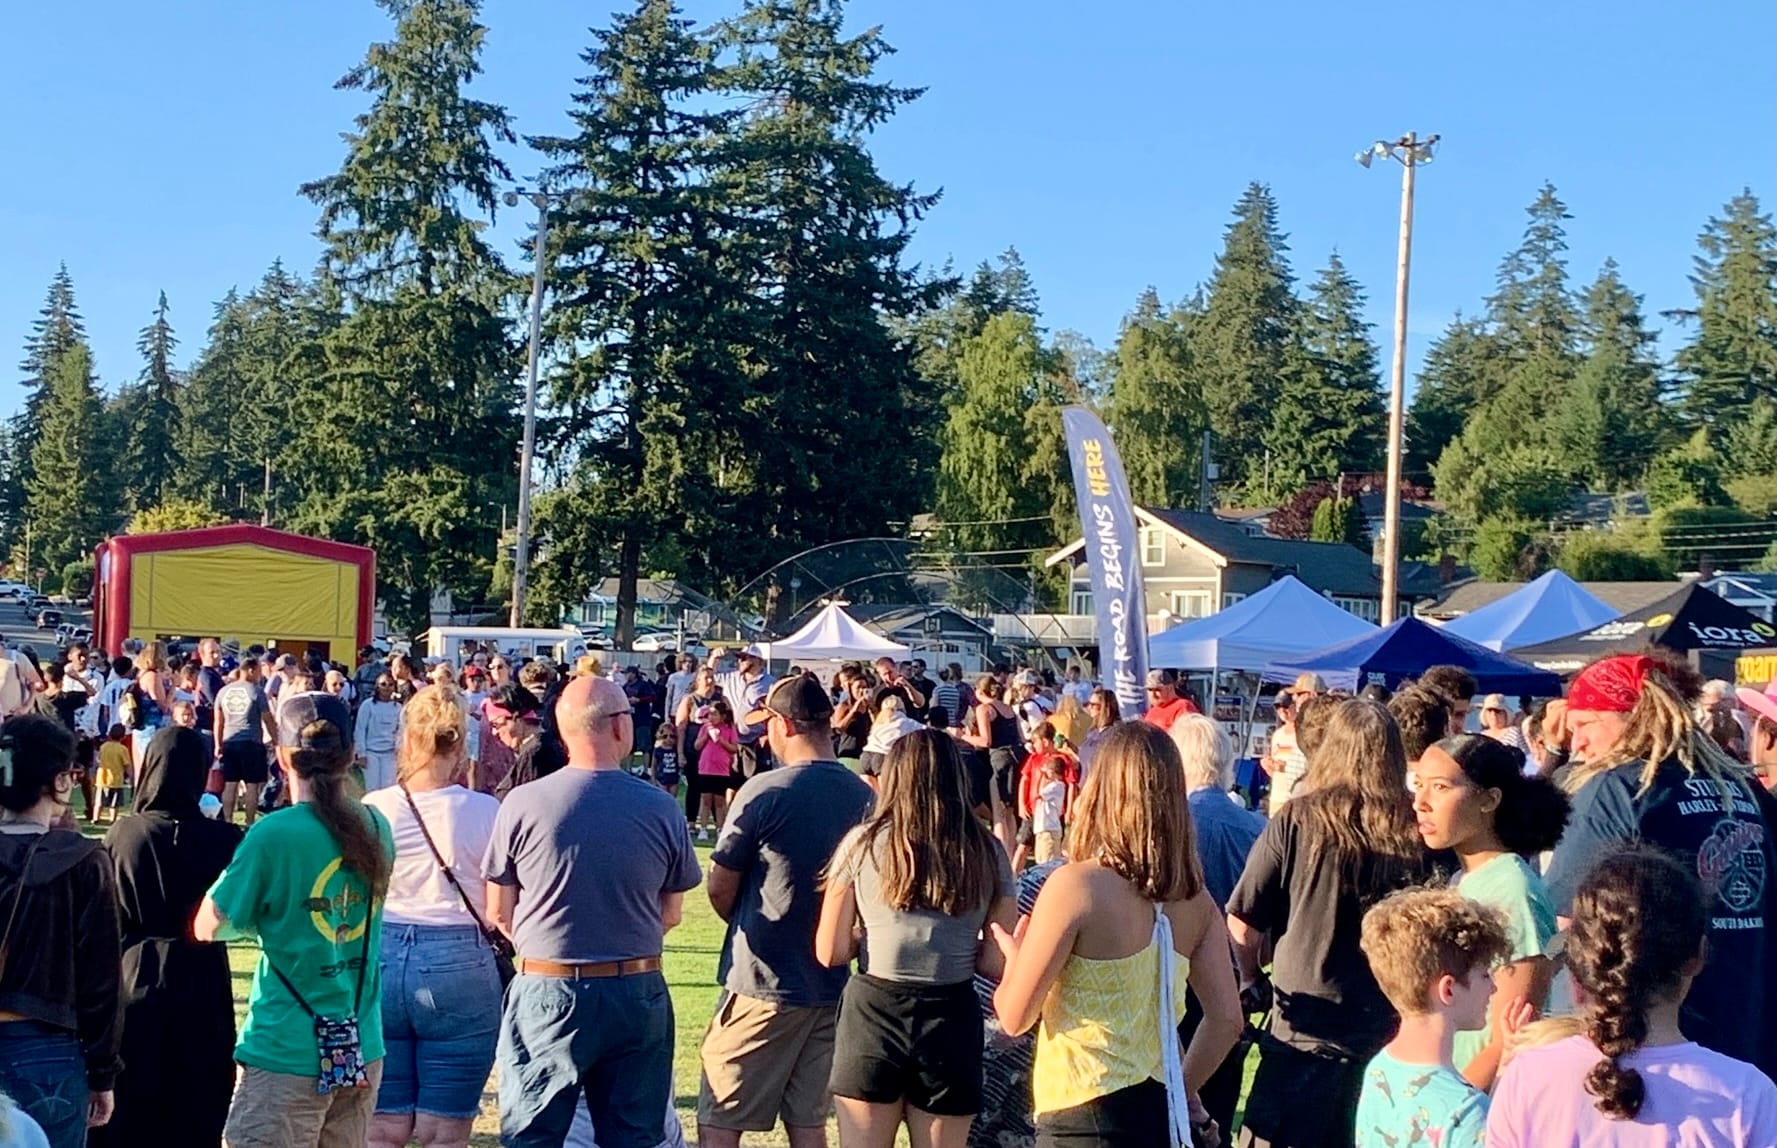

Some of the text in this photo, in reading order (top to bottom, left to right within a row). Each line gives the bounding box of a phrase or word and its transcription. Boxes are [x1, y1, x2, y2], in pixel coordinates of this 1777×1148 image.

[1083, 438, 1111, 496] HERE
[1093, 503, 1124, 591] BEGINS
[1110, 598, 1132, 661] ROAD
[1688, 622, 1767, 643] iora
[1114, 668, 1145, 708] THE
